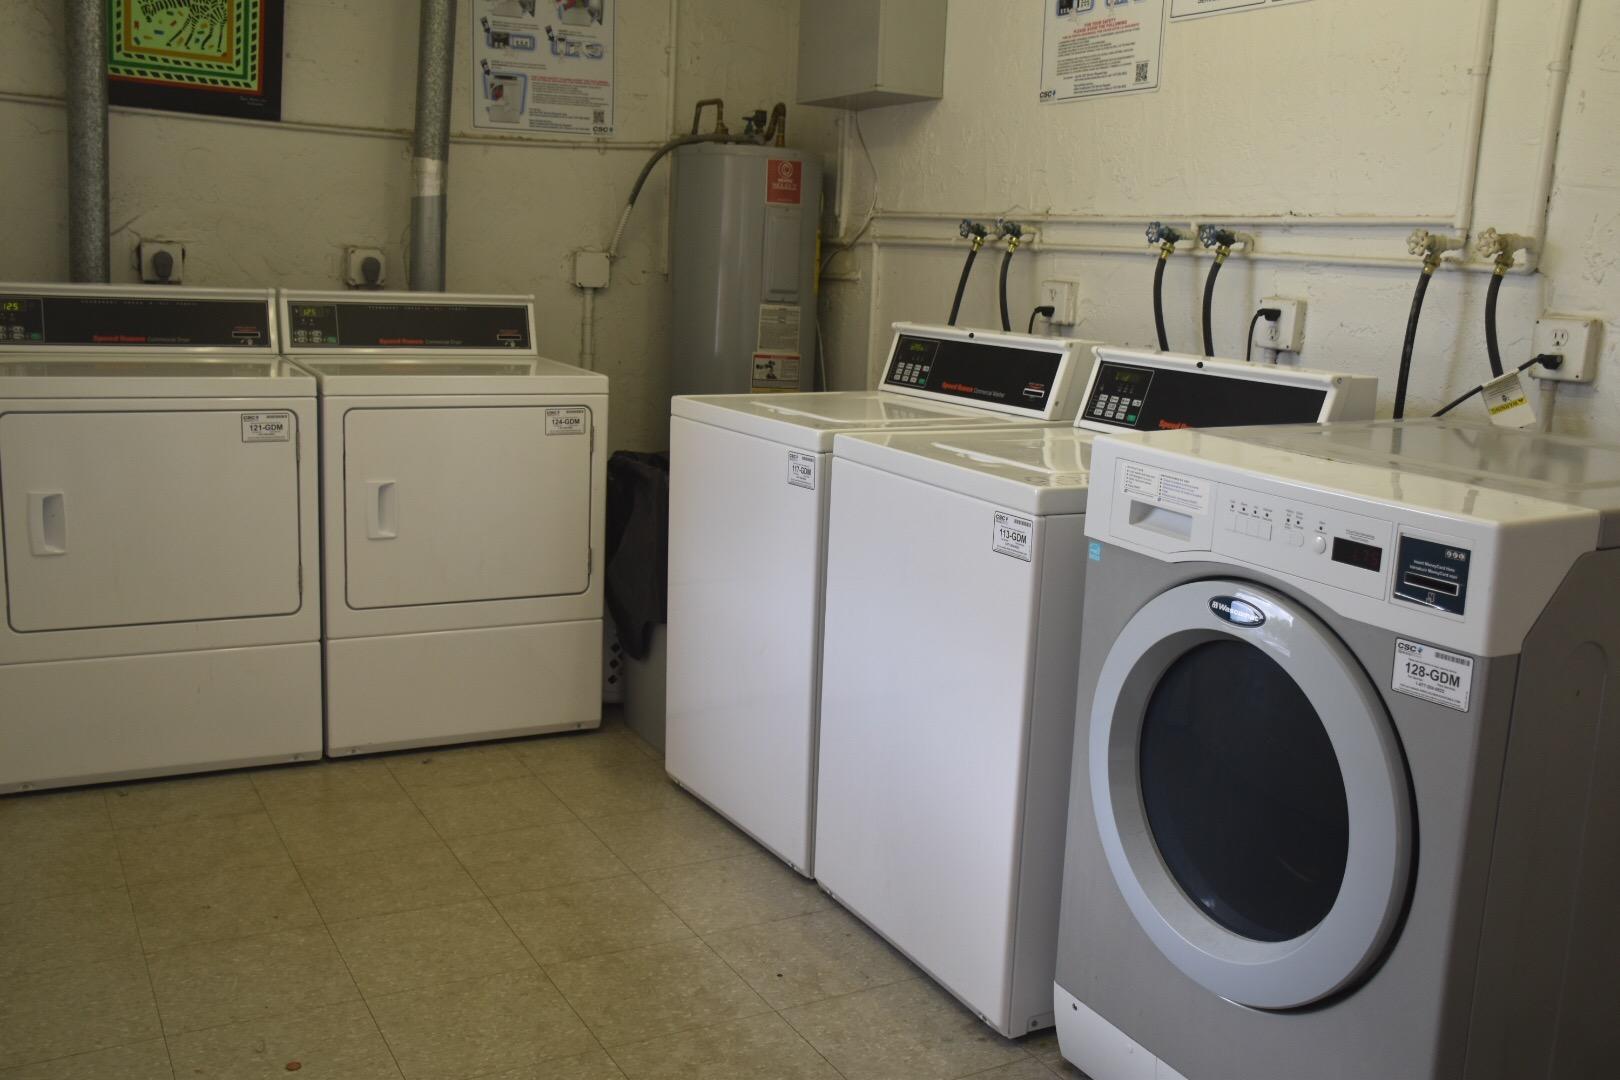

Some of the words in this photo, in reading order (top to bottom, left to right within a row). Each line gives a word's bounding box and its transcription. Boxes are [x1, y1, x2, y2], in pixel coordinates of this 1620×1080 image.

[250, 423, 283, 432] 121-GDM
[999, 528, 1027, 544] 113-GDM
[1218, 602, 1259, 622] Wascoat
[1397, 642, 1417, 653] CSC
[1405, 662, 1460, 688] 128-GDM
